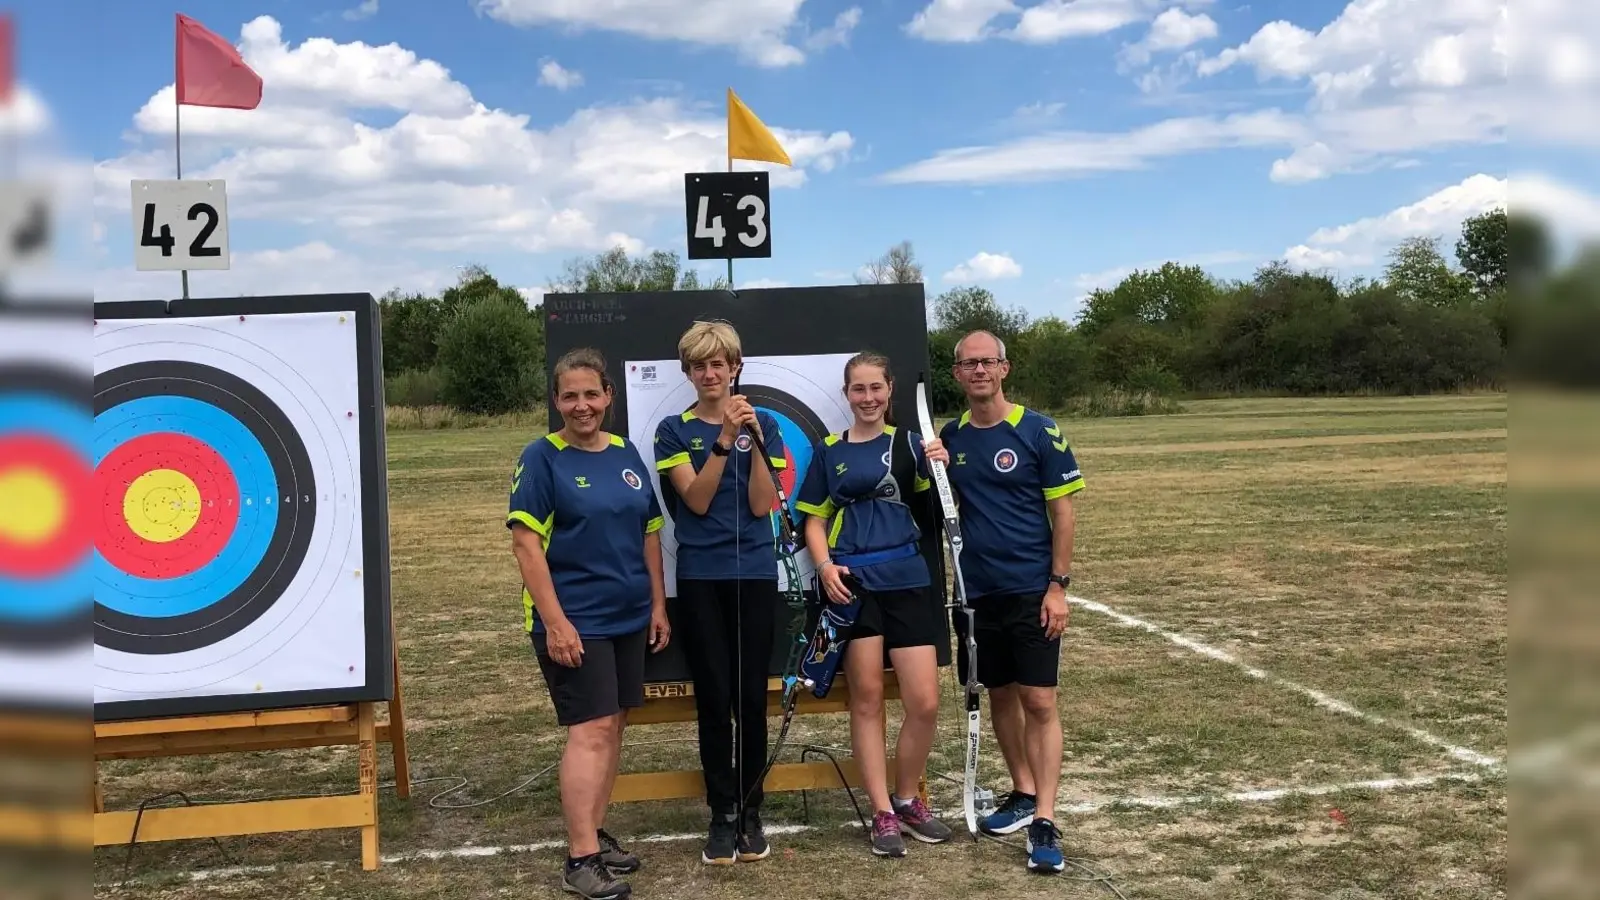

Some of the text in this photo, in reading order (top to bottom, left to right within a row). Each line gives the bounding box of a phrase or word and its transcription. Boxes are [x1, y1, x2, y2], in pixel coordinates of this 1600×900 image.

[140, 202, 221, 256] 42
[694, 194, 767, 248] 43
[564, 312, 613, 324] TARGET
